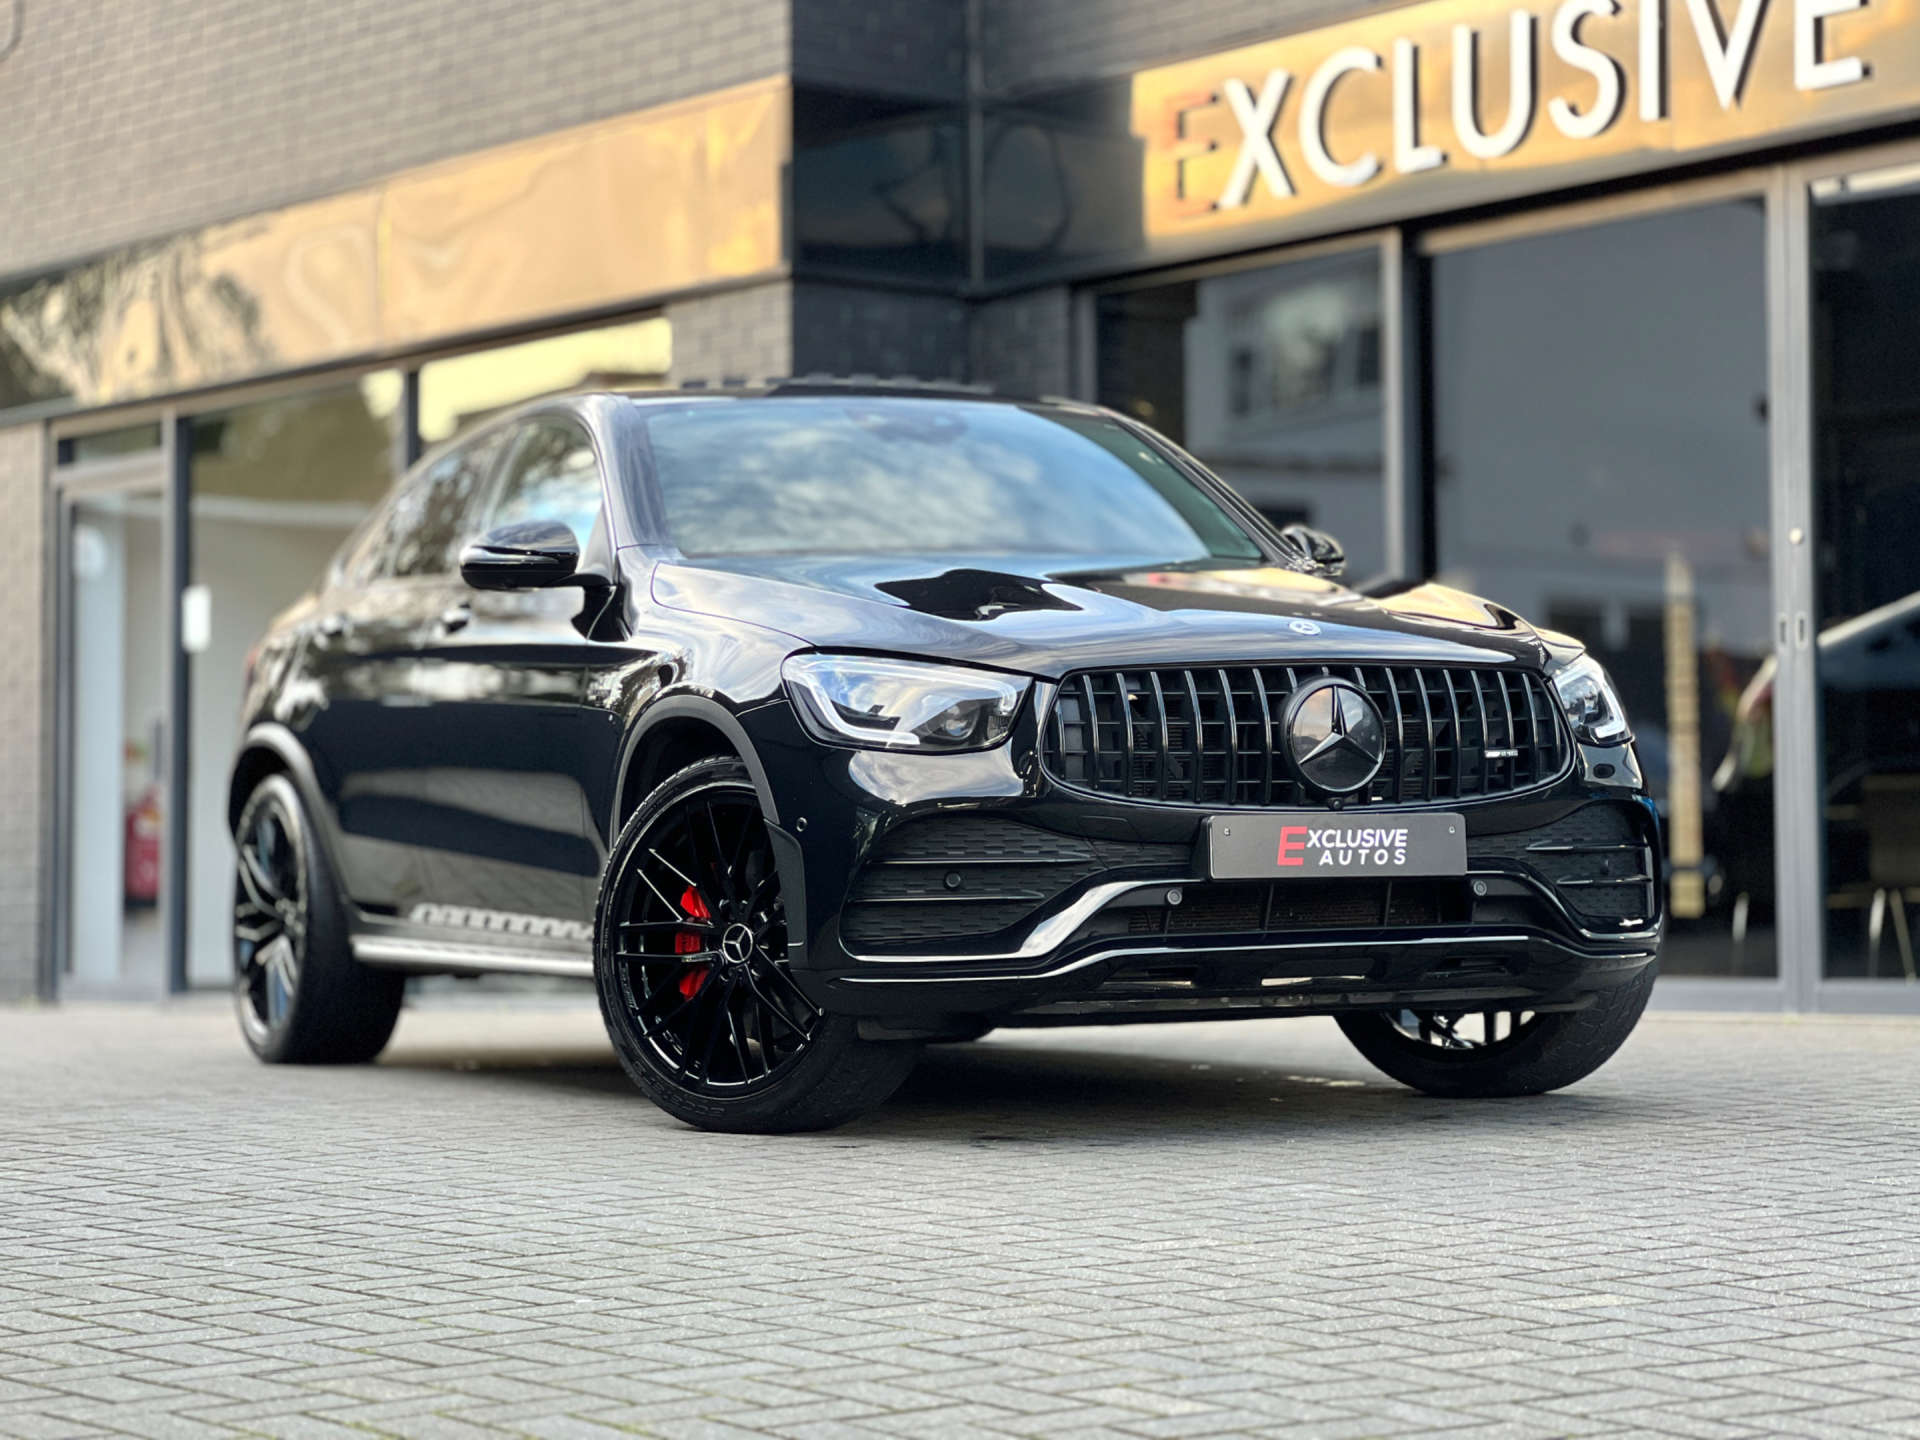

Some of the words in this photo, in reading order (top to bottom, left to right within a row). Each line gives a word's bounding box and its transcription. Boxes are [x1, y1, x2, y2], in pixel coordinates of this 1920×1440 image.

[1163, 0, 1870, 219] EXCLUSIVE
[1277, 826, 1408, 866] EXCLUSIVE
[1319, 849, 1407, 866] AUTOS
